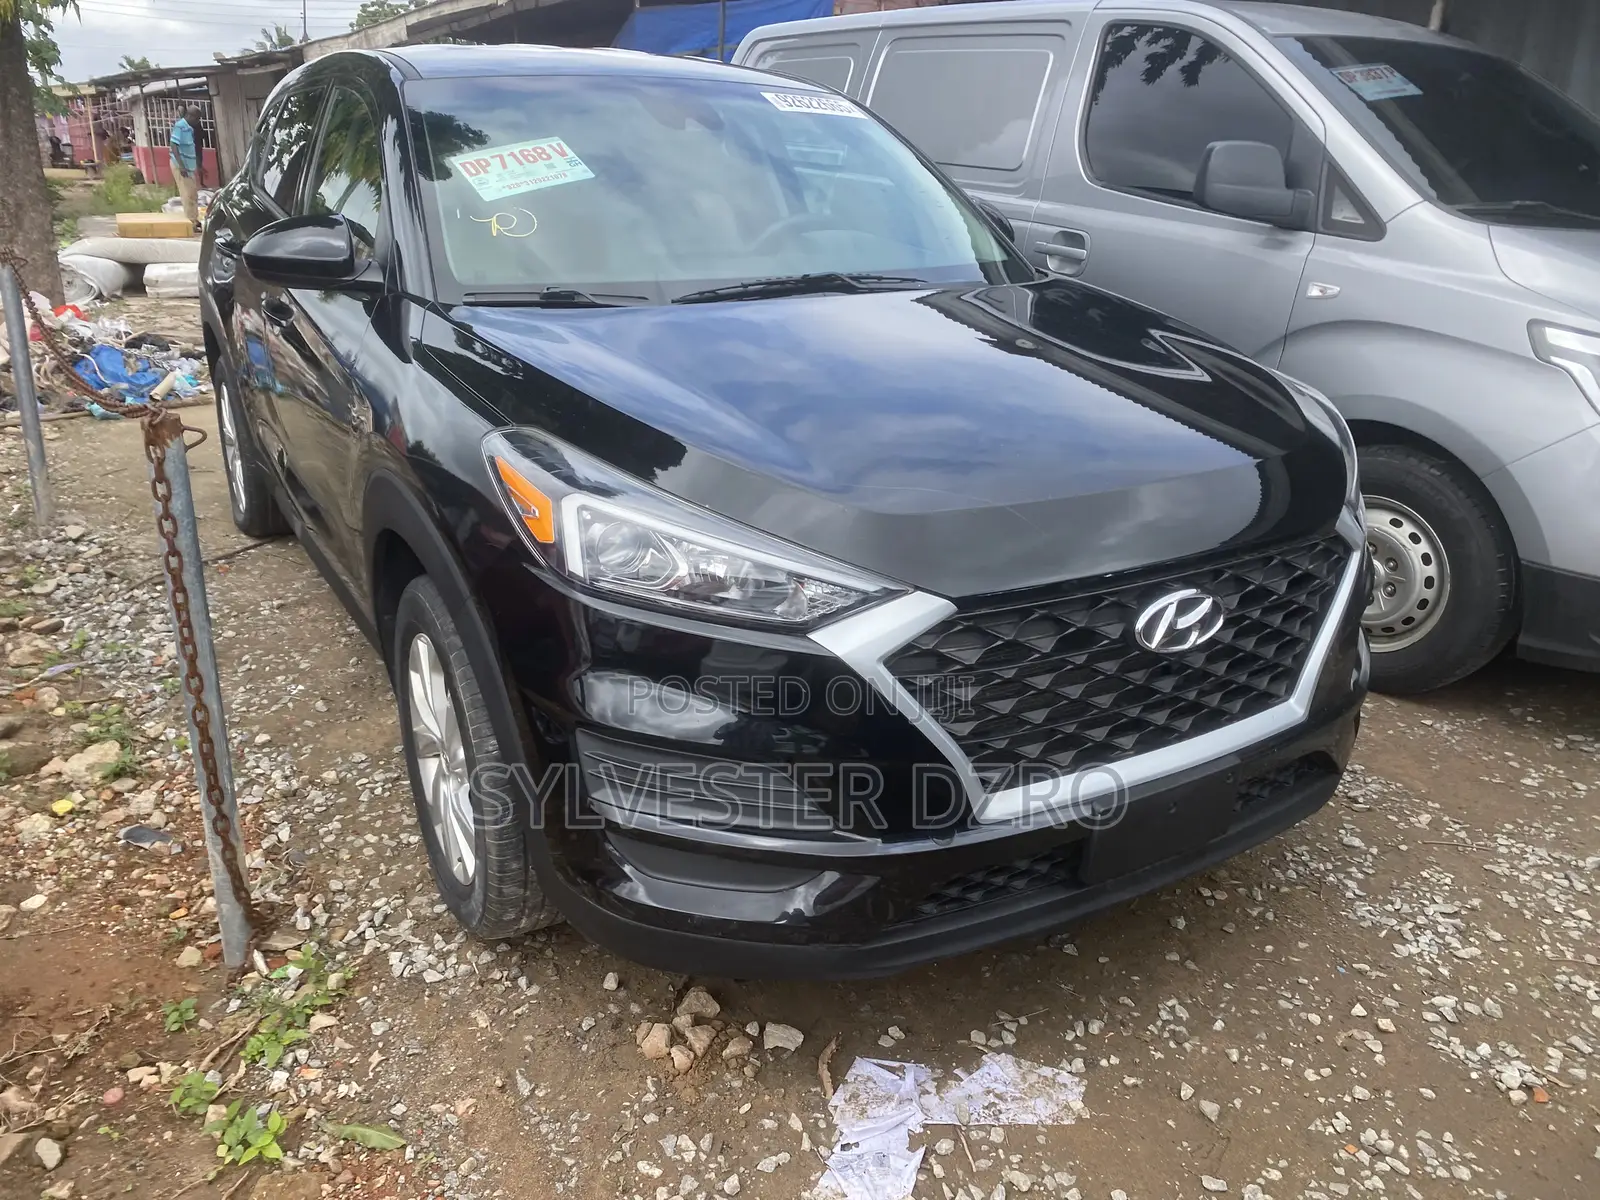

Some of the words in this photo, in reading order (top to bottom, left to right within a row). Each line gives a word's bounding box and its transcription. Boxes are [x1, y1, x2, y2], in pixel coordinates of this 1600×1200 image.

[459, 158, 491, 178] DP
[489, 145, 553, 170] 7168
[547, 142, 569, 159] V
